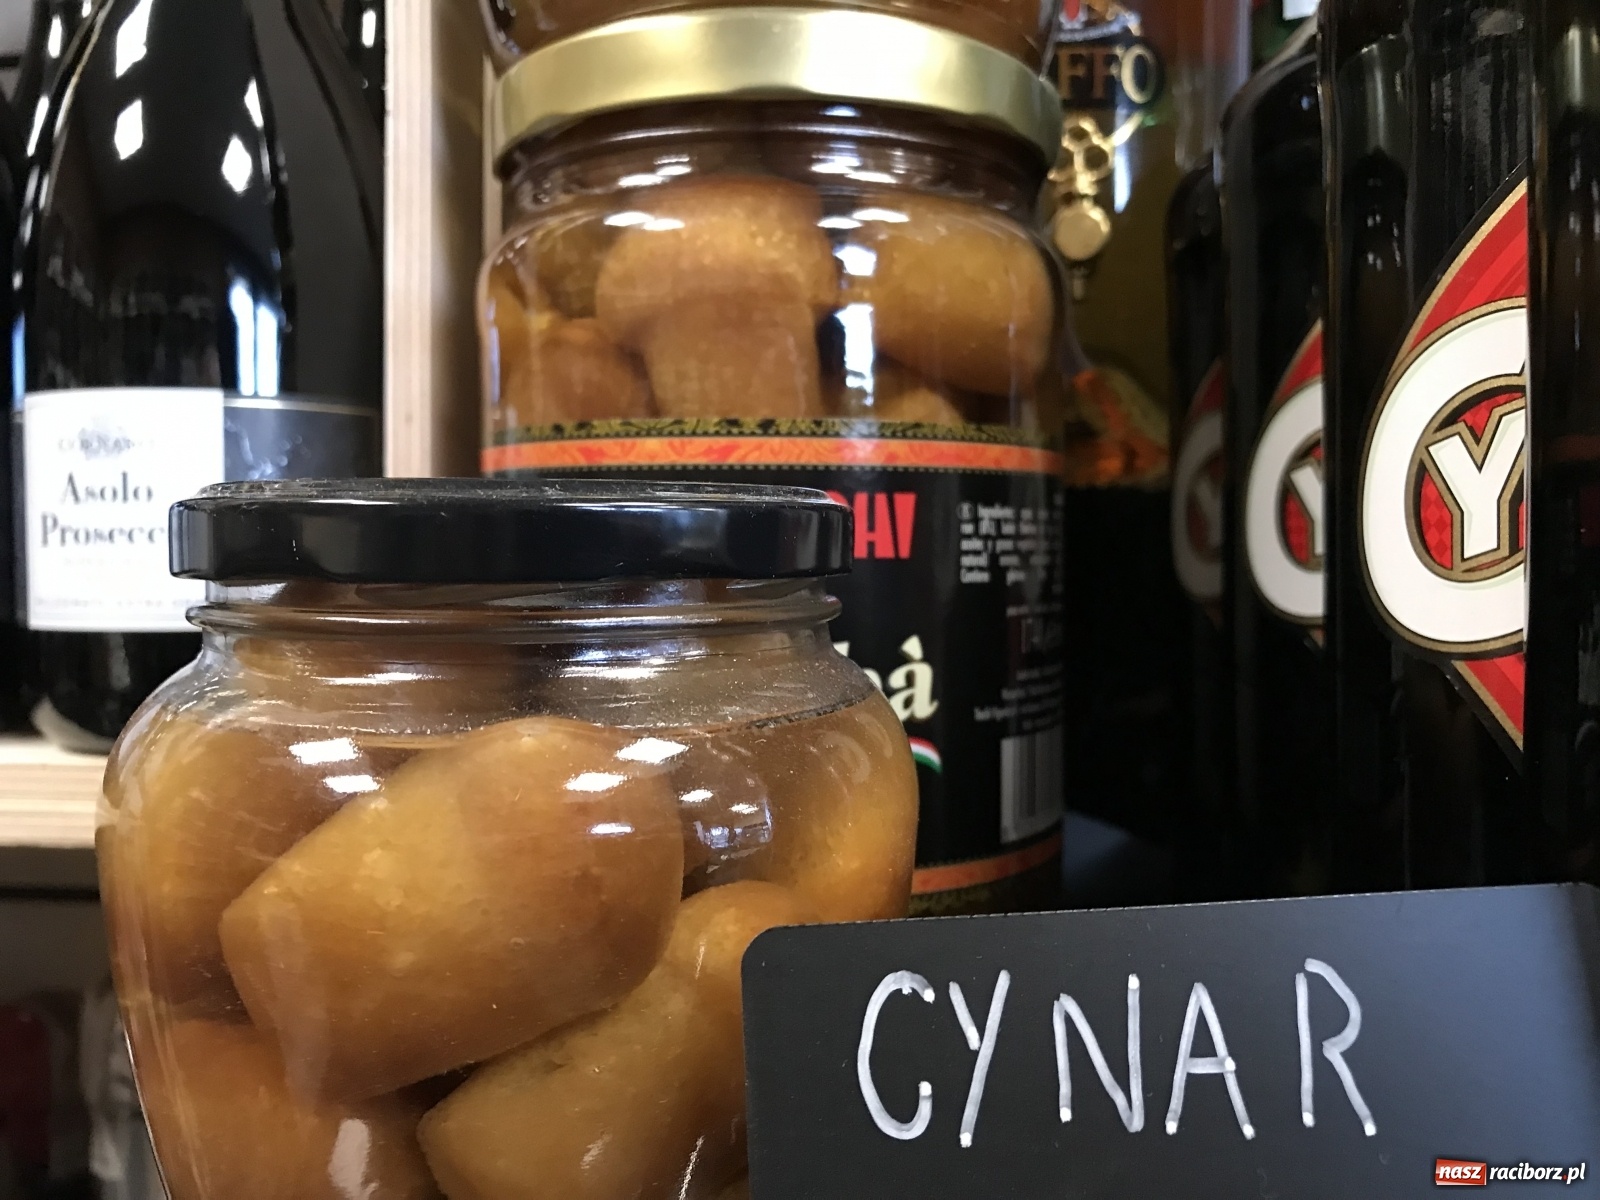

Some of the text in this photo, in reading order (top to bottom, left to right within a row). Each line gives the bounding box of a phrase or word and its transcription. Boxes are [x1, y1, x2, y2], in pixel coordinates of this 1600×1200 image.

[58, 470, 153, 505] Asolo
[827, 488, 917, 560] HI
[857, 957, 1377, 1149] CYNAR
